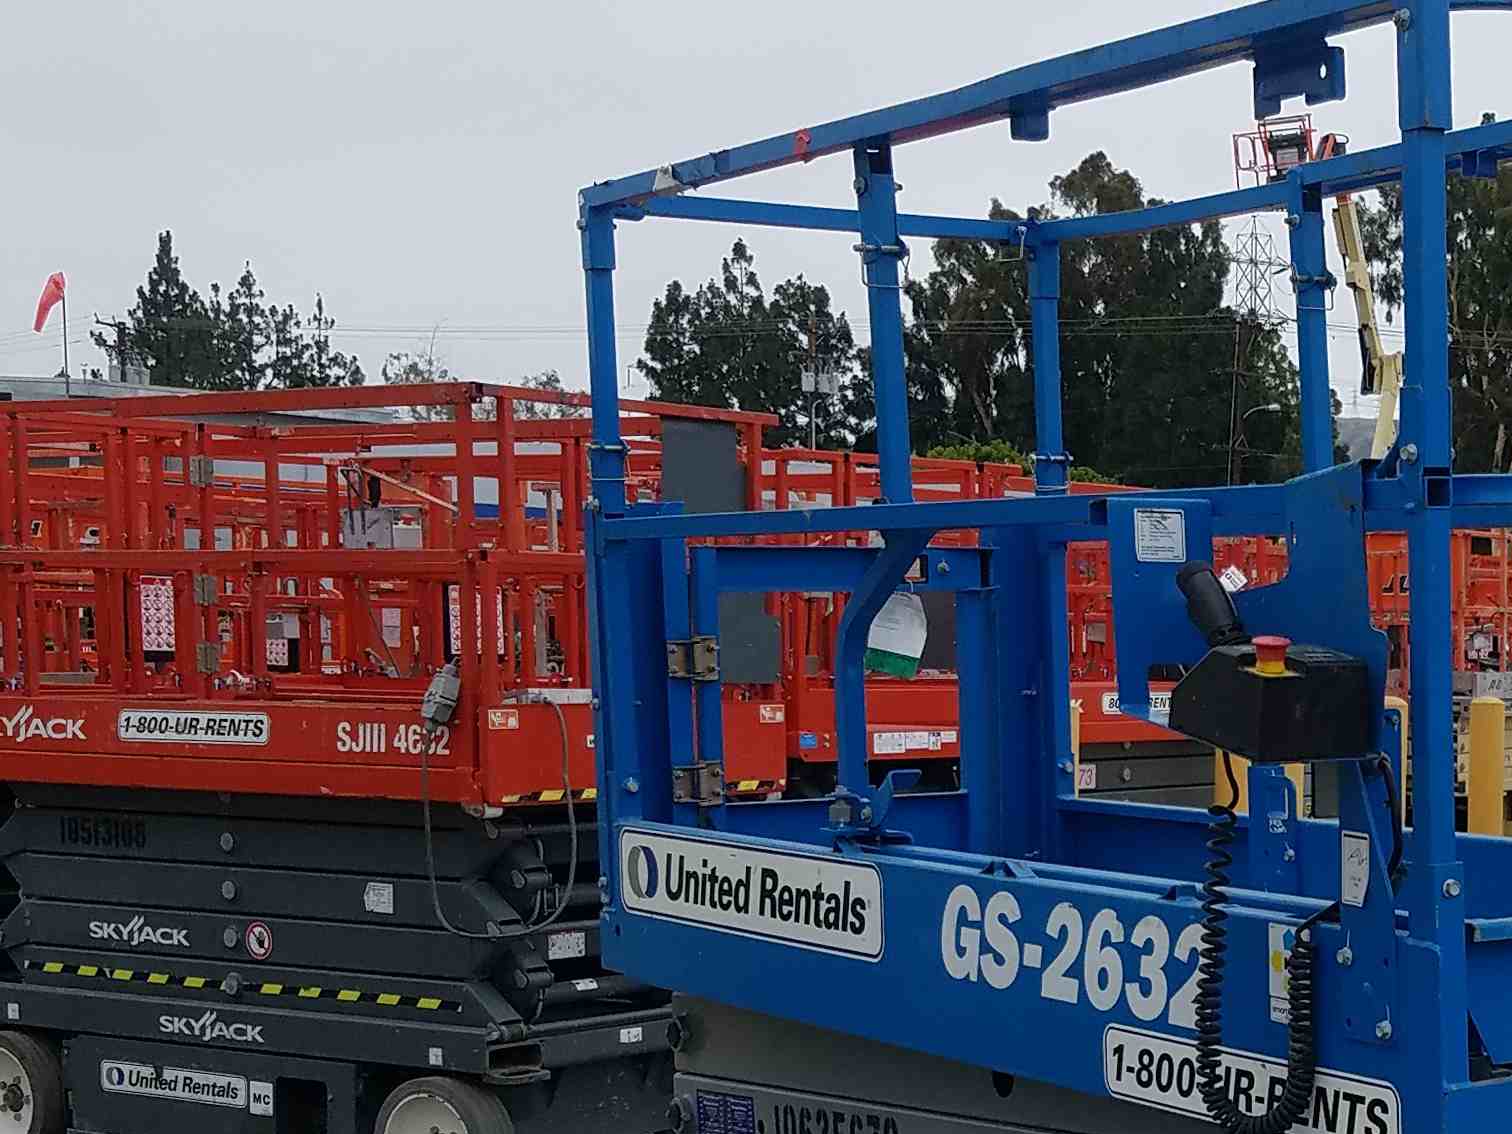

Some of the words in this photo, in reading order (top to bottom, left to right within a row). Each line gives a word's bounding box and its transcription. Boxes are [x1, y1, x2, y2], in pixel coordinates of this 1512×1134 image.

[0, 704, 88, 742] YJACK
[122, 715, 265, 738] 1-800-UR-RENTS
[665, 852, 752, 915] United
[759, 866, 867, 935] Rentals
[89, 915, 190, 947] SKYJACK
[941, 884, 1206, 1030] GS-2632
[159, 1009, 264, 1043] SKYJACK
[128, 1070, 179, 1092] United
[182, 1077, 239, 1100] Rentals
[252, 1093, 271, 1105] MC
